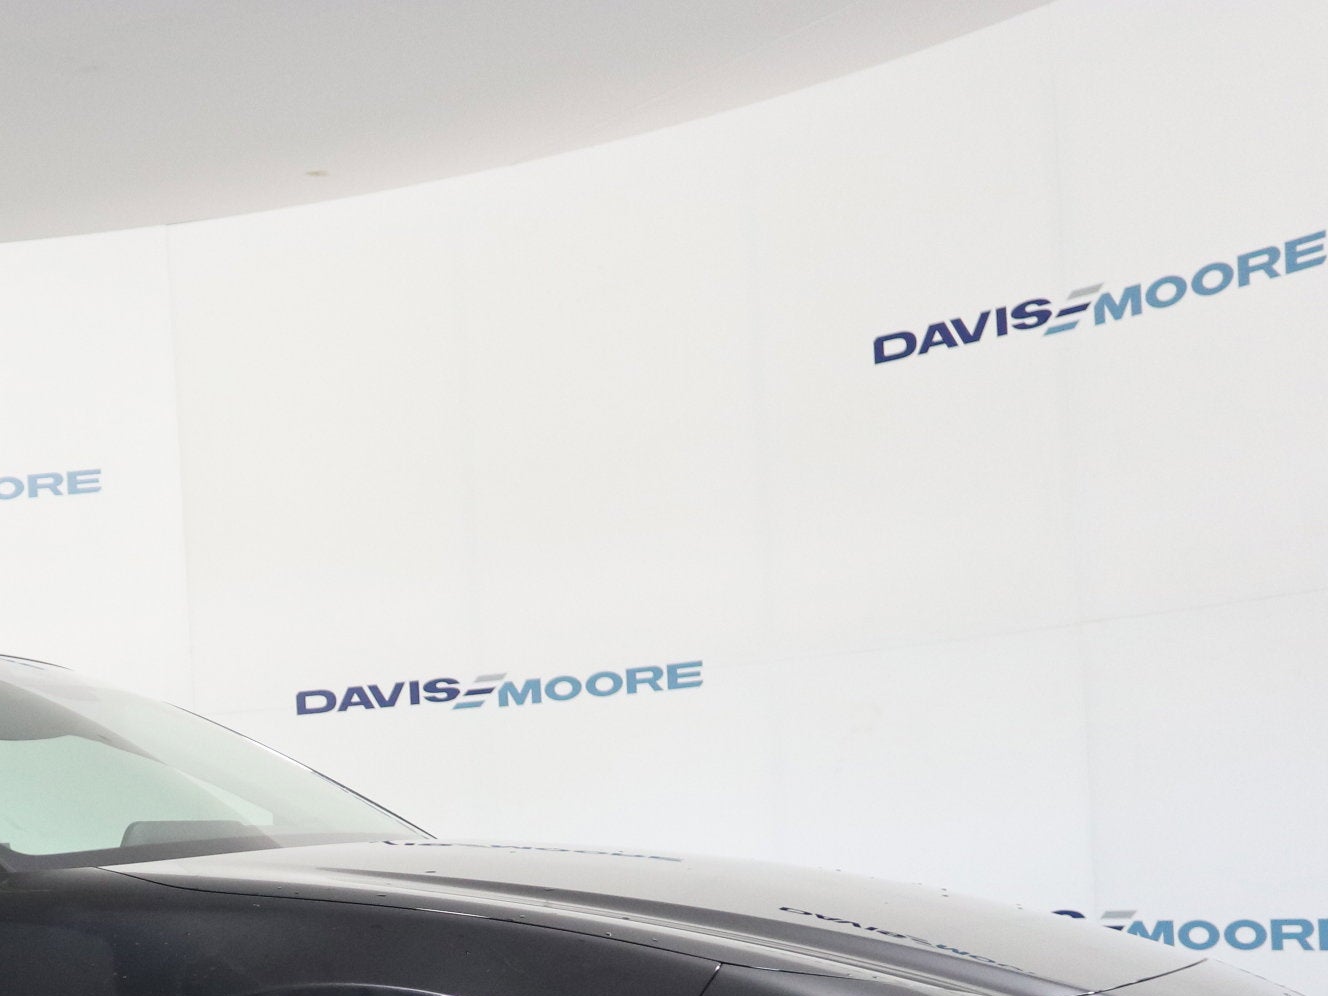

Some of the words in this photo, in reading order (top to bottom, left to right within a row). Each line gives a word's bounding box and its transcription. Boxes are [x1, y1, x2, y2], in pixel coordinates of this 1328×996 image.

[873, 298, 1053, 365] DAVIS
[1093, 229, 1327, 325] MOORE
[295, 677, 461, 716] DAVIS
[497, 659, 704, 708] MOORE
[1126, 918, 1328, 951] MOOR
